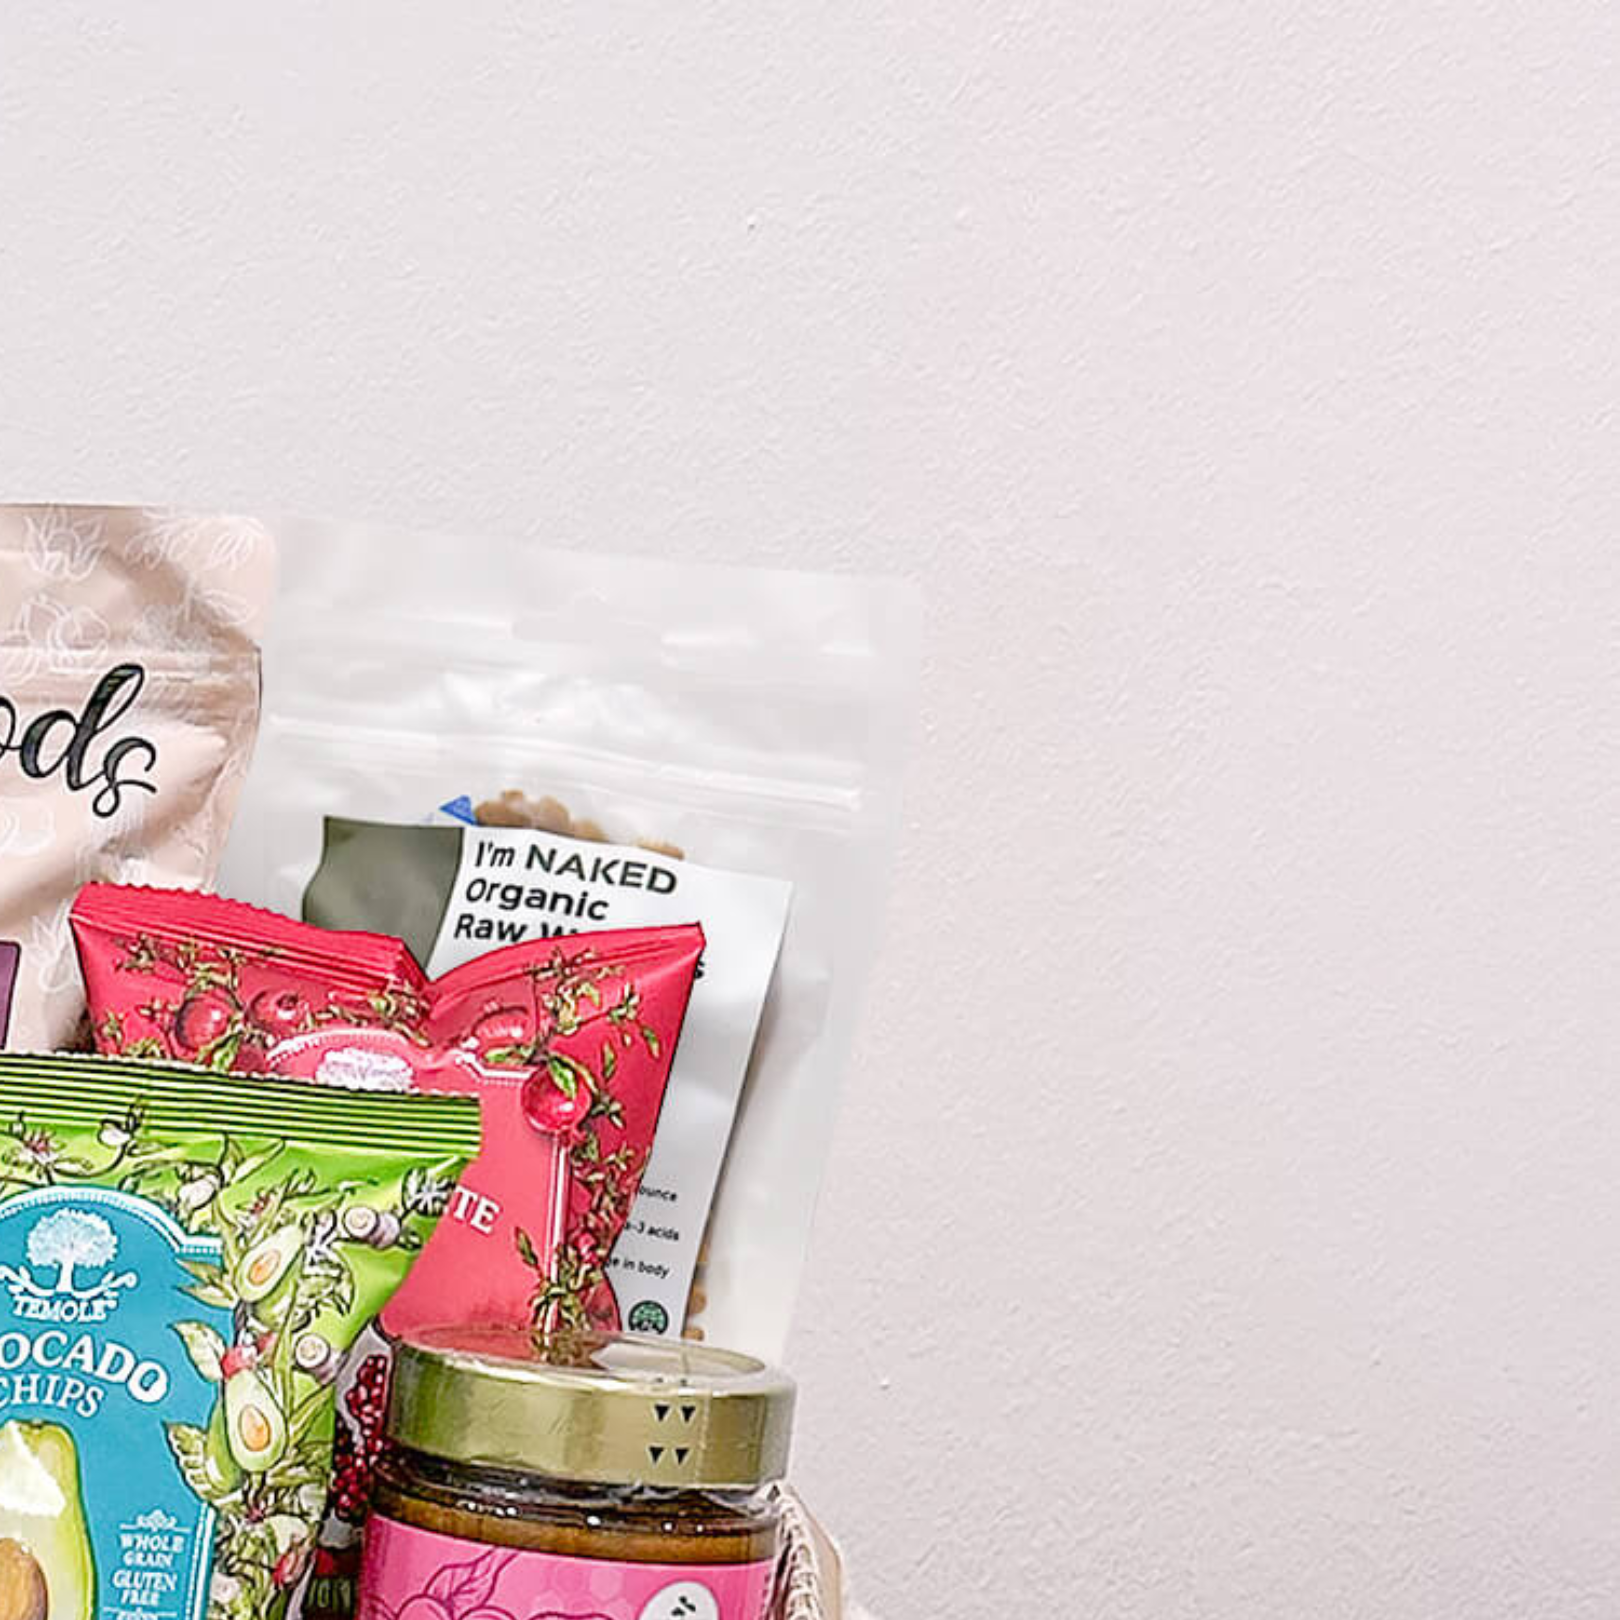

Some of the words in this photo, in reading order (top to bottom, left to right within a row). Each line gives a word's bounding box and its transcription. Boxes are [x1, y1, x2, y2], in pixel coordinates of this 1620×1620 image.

[474, 840, 516, 868] I'm
[526, 843, 678, 895] NAKED
[465, 878, 611, 921] Organic
[453, 913, 529, 943] Raw
[120, 1533, 184, 1553] WHOLE
[112, 1569, 178, 1591] GLUTEN
